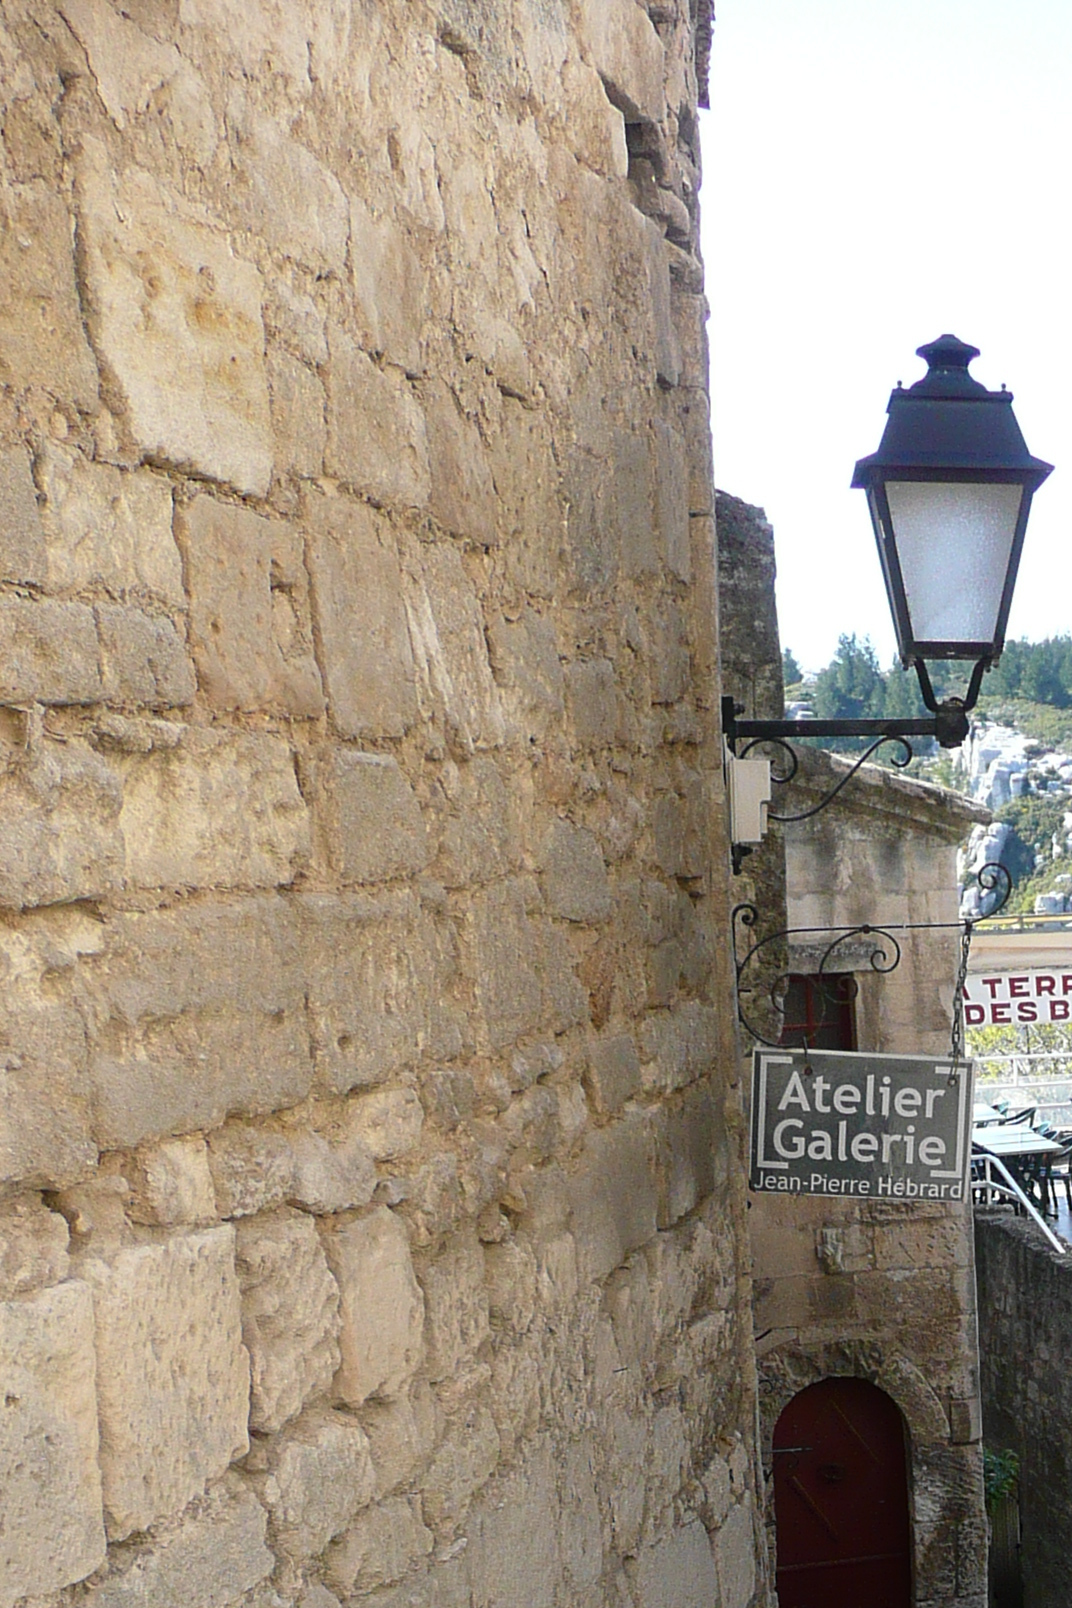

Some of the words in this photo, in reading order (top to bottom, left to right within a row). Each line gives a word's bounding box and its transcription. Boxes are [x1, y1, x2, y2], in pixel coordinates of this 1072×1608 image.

[964, 1001, 1038, 1026] DES
[777, 1070, 946, 1120] Atelier
[772, 1118, 946, 1166] Galerie
[753, 1170, 871, 1195] Jean-Pierre
[877, 1176, 963, 1199] Hébrard
